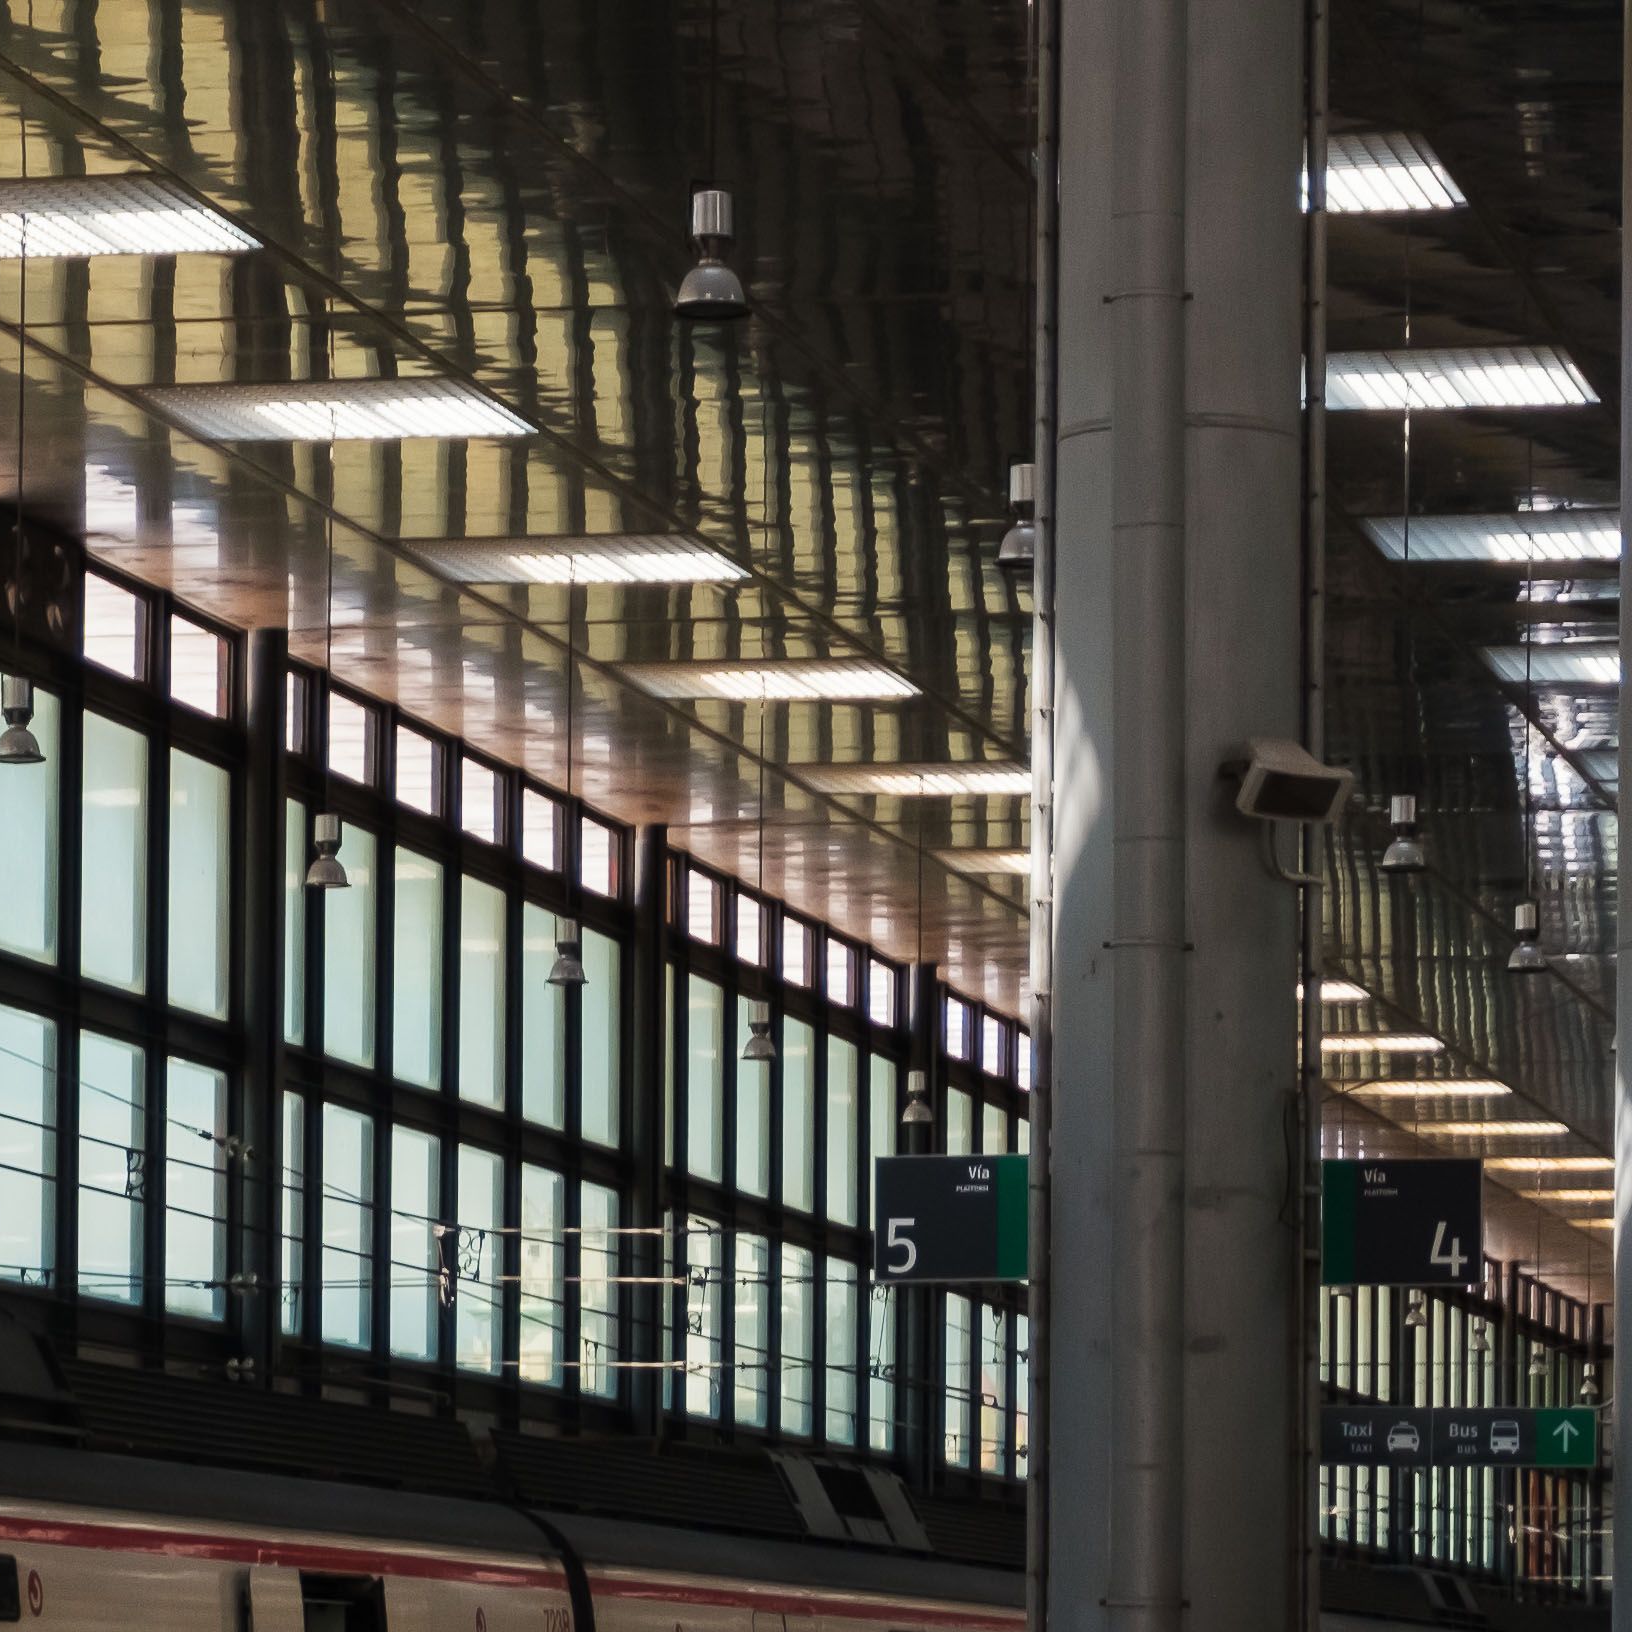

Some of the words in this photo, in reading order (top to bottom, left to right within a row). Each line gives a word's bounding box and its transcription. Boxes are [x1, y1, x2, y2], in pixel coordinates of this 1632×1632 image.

[968, 1164, 990, 1180] Vía
[1363, 1168, 1386, 1184] Vía
[887, 1217, 917, 1274] 5
[1430, 1220, 1468, 1278] 4
[1341, 1421, 1373, 1438] Taxi
[1449, 1423, 1479, 1438] Bus
